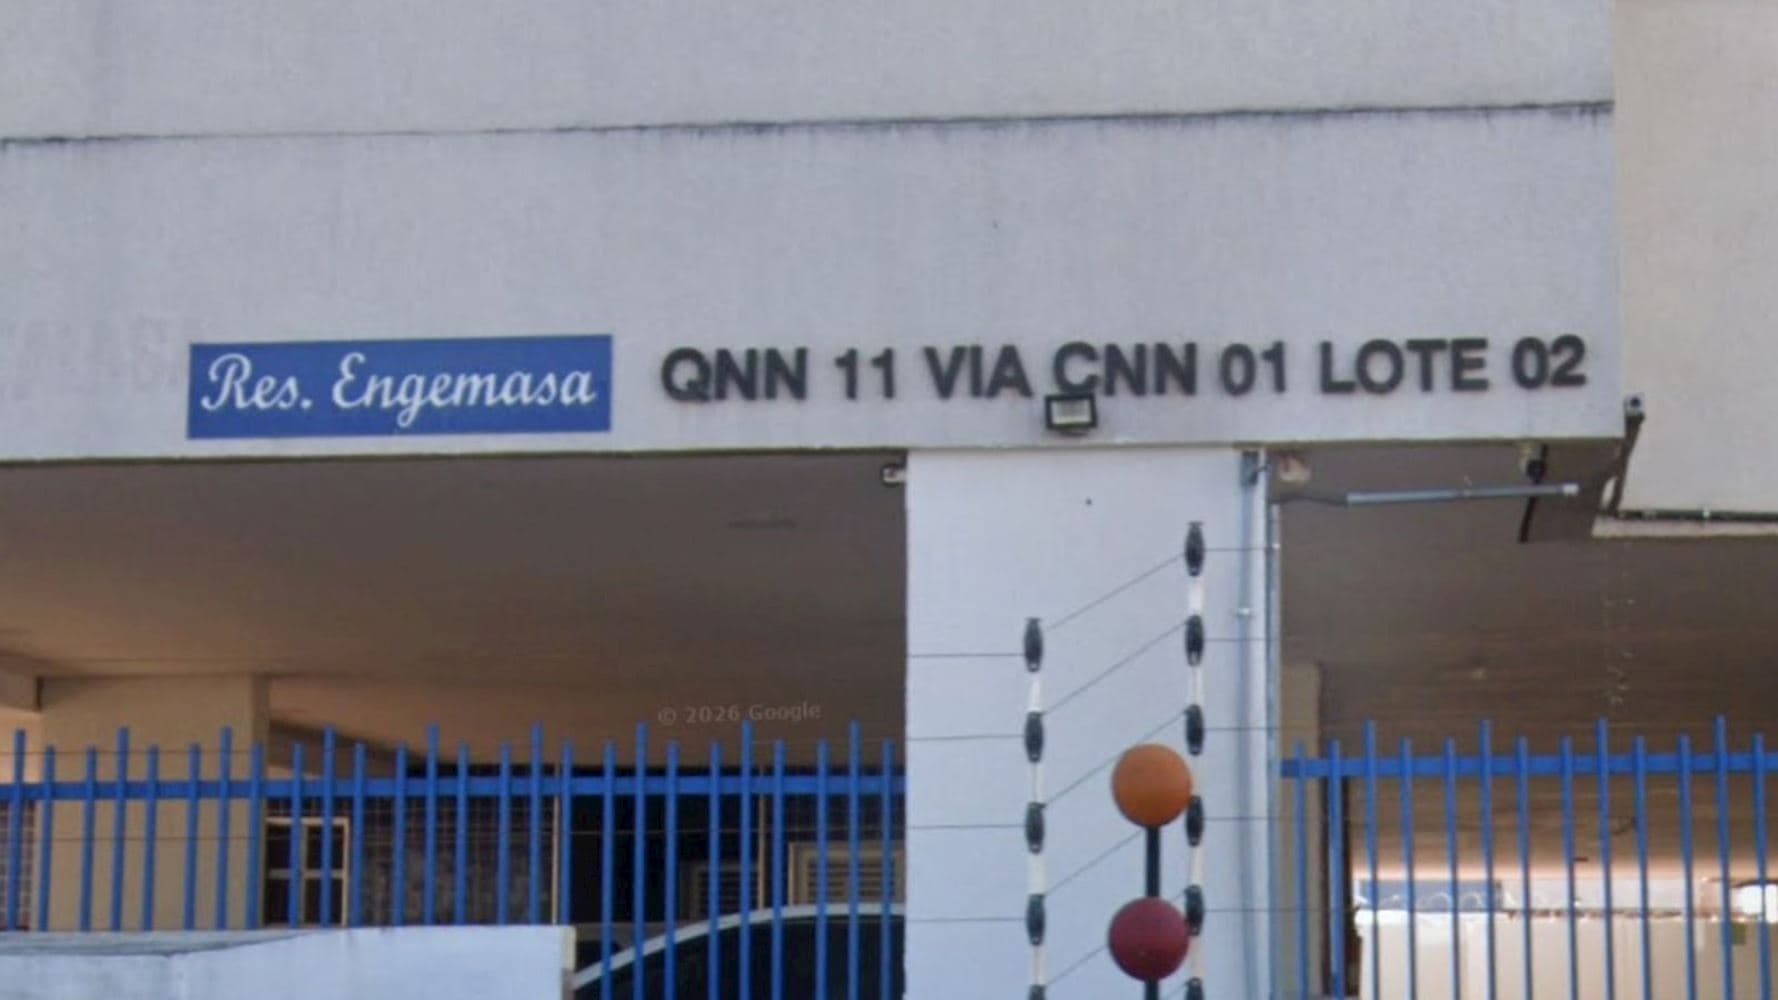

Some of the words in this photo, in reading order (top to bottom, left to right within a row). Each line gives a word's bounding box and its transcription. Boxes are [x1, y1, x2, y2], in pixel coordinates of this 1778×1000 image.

[201, 353, 312, 410] Res.
[332, 351, 596, 429] Engemasa
[660, 346, 809, 403] QNN
[834, 347, 896, 400] 11
[922, 344, 1034, 400] VIA
[1052, 341, 1198, 397] CNN
[1219, 340, 1286, 397] 01
[1319, 337, 1489, 396] LOTE
[1511, 333, 1587, 389] 02
